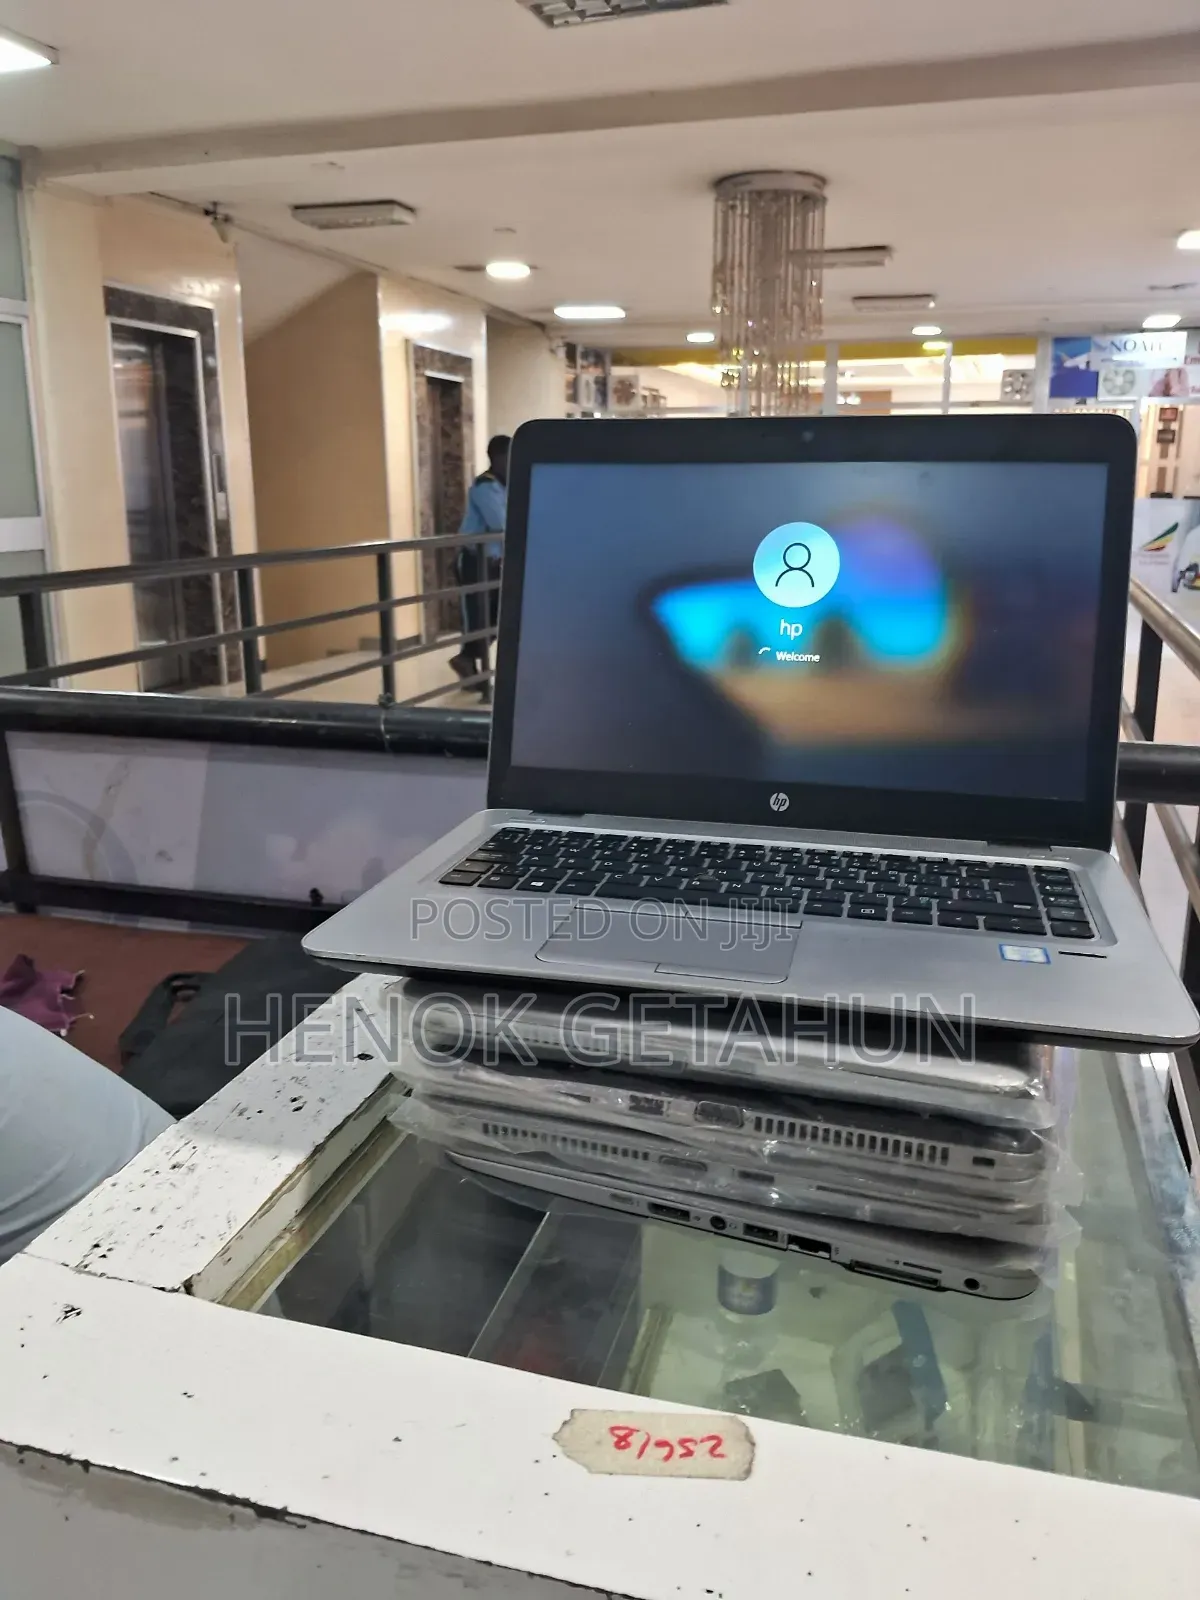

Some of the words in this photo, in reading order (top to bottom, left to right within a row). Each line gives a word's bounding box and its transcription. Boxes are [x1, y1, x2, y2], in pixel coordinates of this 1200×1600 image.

[780, 619, 803, 640] hp
[775, 651, 820, 662] Welcome
[771, 792, 789, 812] hp
